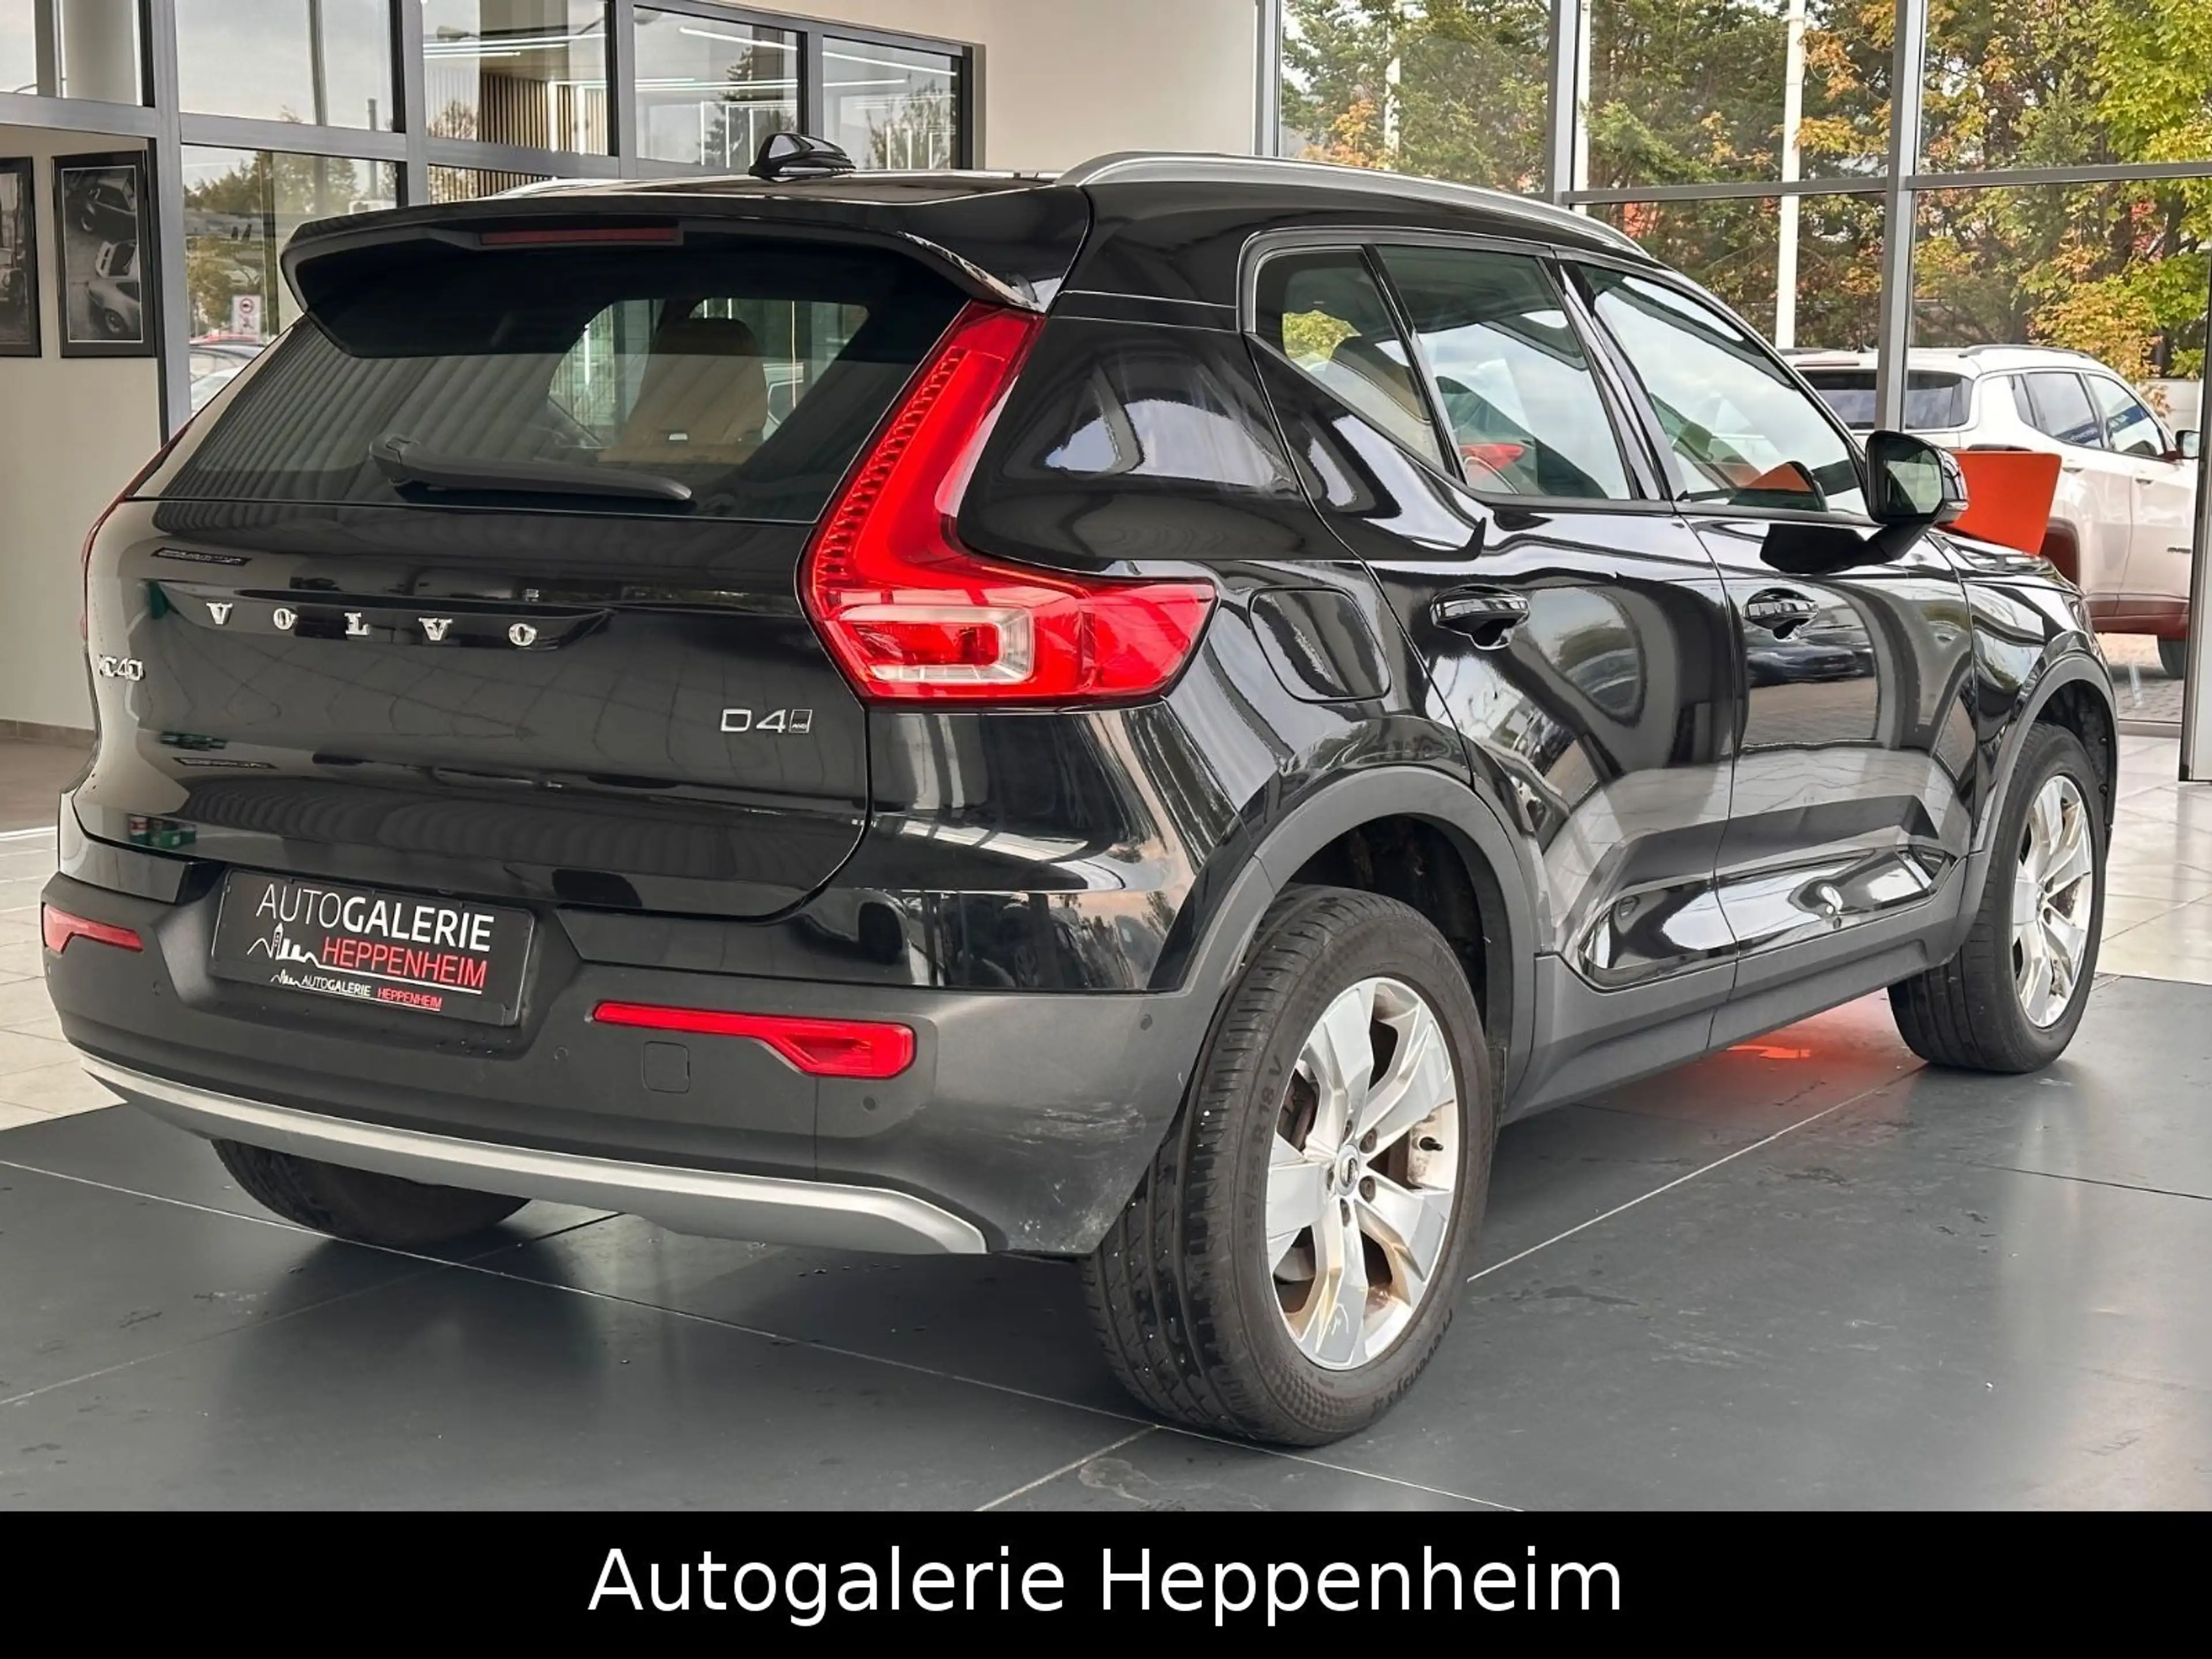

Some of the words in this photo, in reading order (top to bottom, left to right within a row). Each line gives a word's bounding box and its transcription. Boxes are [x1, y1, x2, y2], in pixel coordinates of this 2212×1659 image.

[206, 601, 537, 647] VOLVO
[721, 709, 786, 733] D4
[256, 883, 494, 952] AUTOGALERIE
[322, 936, 487, 988] HEPPENHEIM
[301, 974, 372, 997] AUTOGALERIE
[377, 987, 443, 1009] HEPPENHEIM
